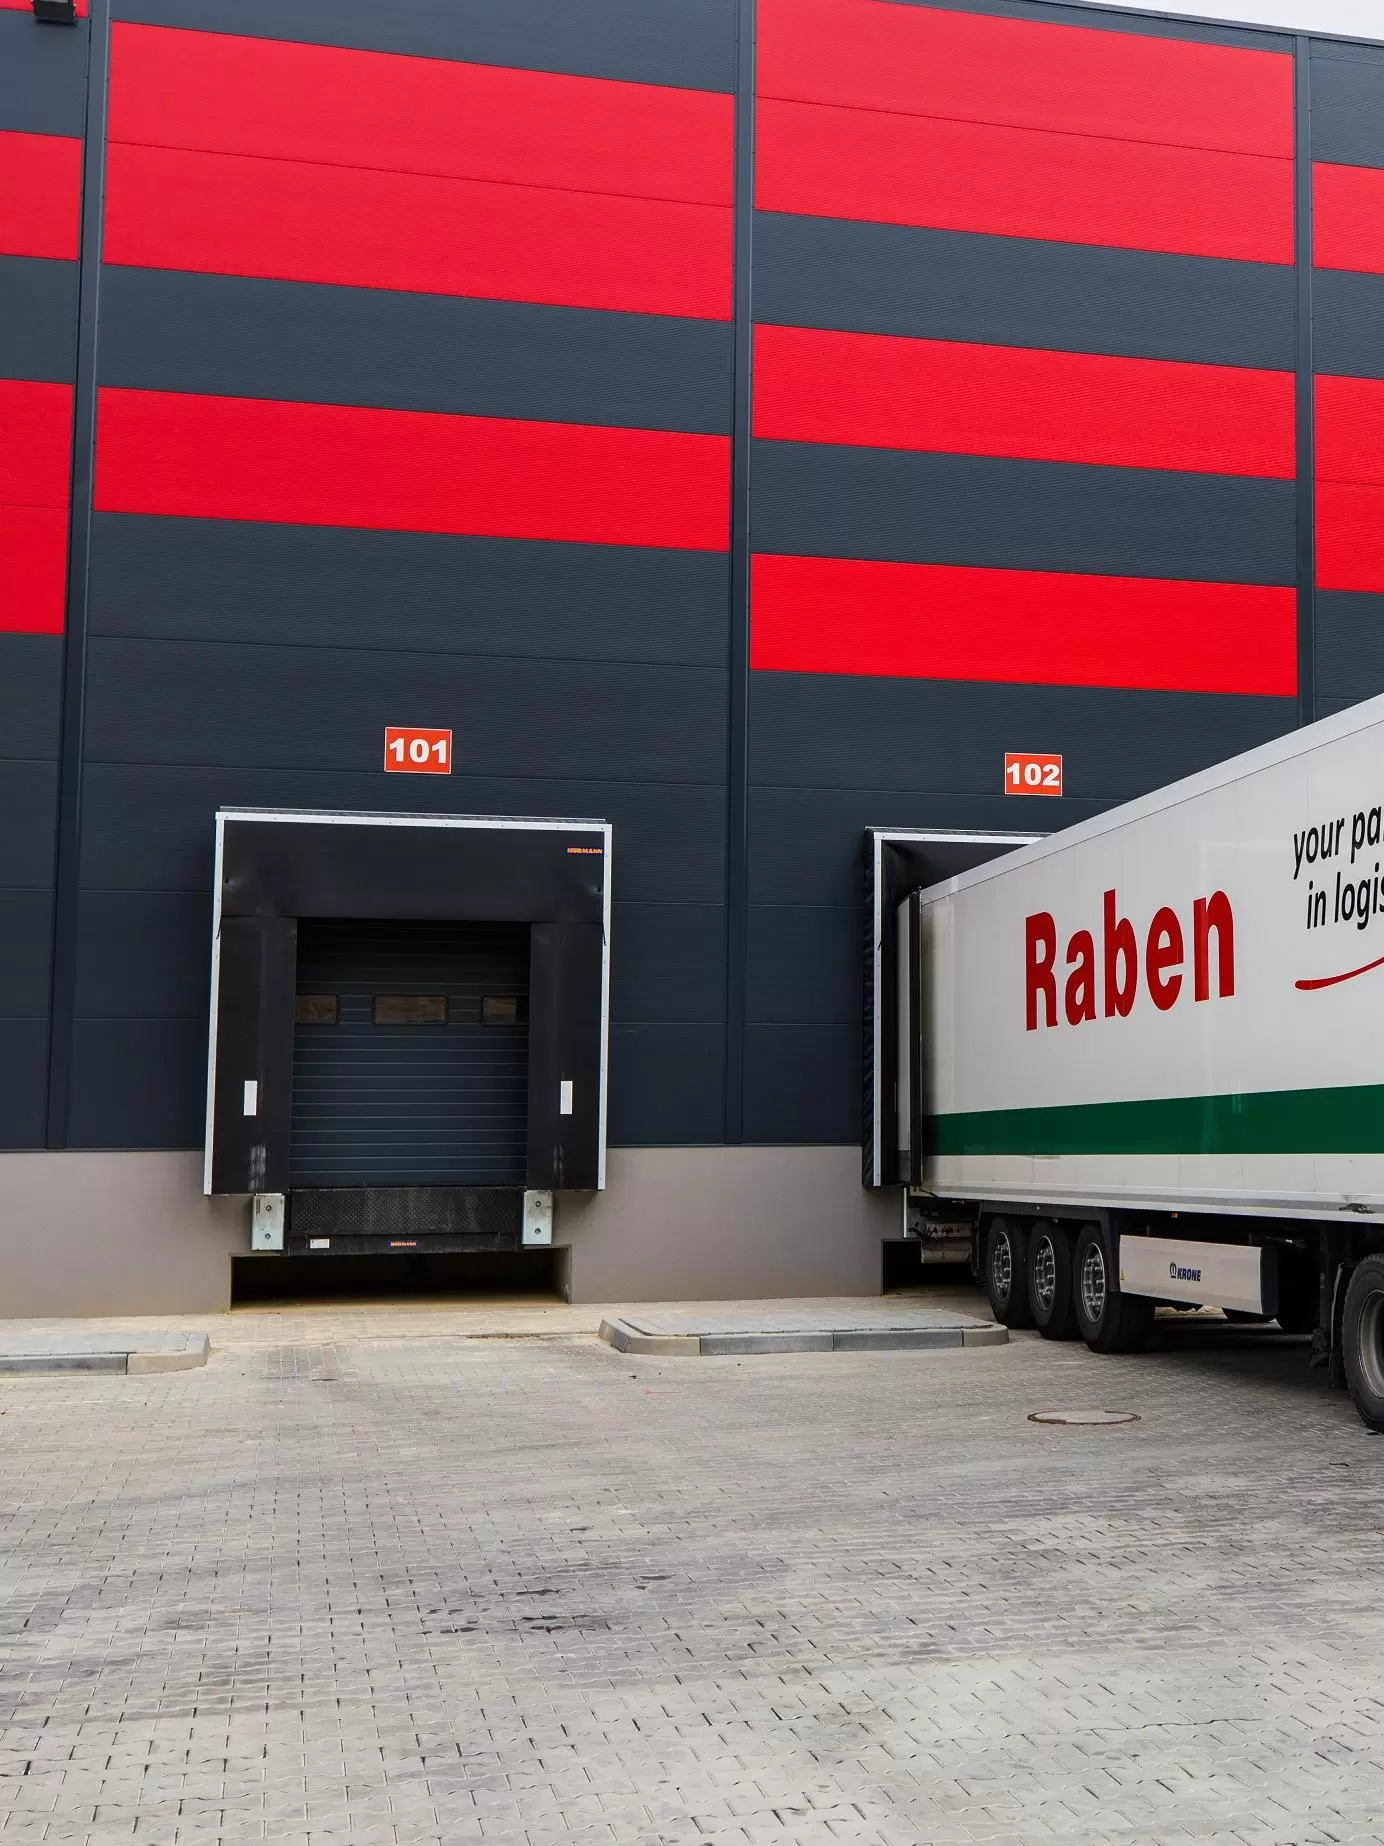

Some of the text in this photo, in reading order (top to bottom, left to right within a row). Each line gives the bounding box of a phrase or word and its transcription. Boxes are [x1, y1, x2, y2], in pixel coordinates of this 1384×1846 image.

[389, 738, 447, 764] 101
[1006, 762, 1060, 786] 102
[1293, 816, 1346, 879] your
[1306, 880, 1328, 930] in
[1025, 888, 1235, 1031] Raben
[1177, 1267, 1201, 1282] KRONE
